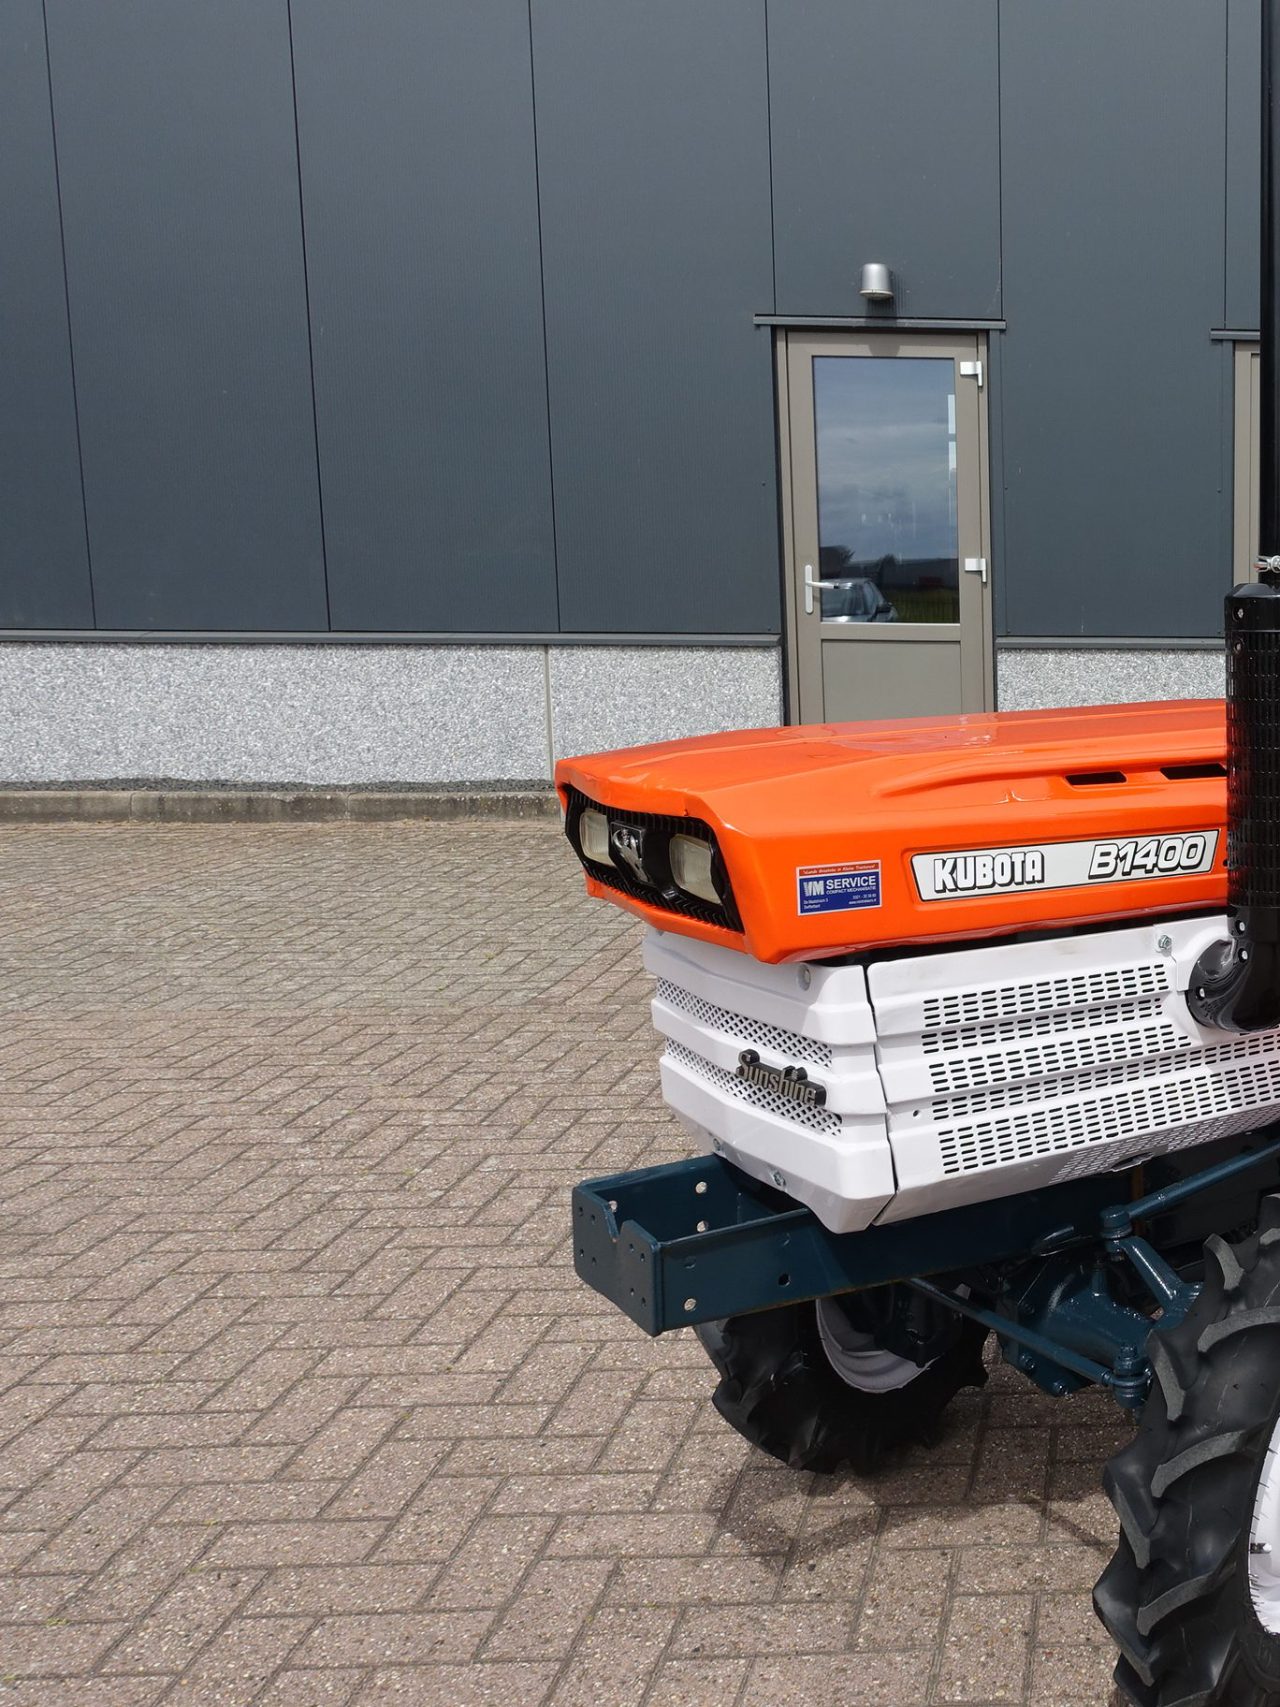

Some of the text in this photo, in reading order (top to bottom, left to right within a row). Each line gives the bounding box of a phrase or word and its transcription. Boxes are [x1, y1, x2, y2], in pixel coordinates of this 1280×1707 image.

[803, 876, 876, 897] VM SERVICE
[934, 835, 1206, 893] KUBOTA B1400
[736, 1049, 822, 1107] Sunshine
